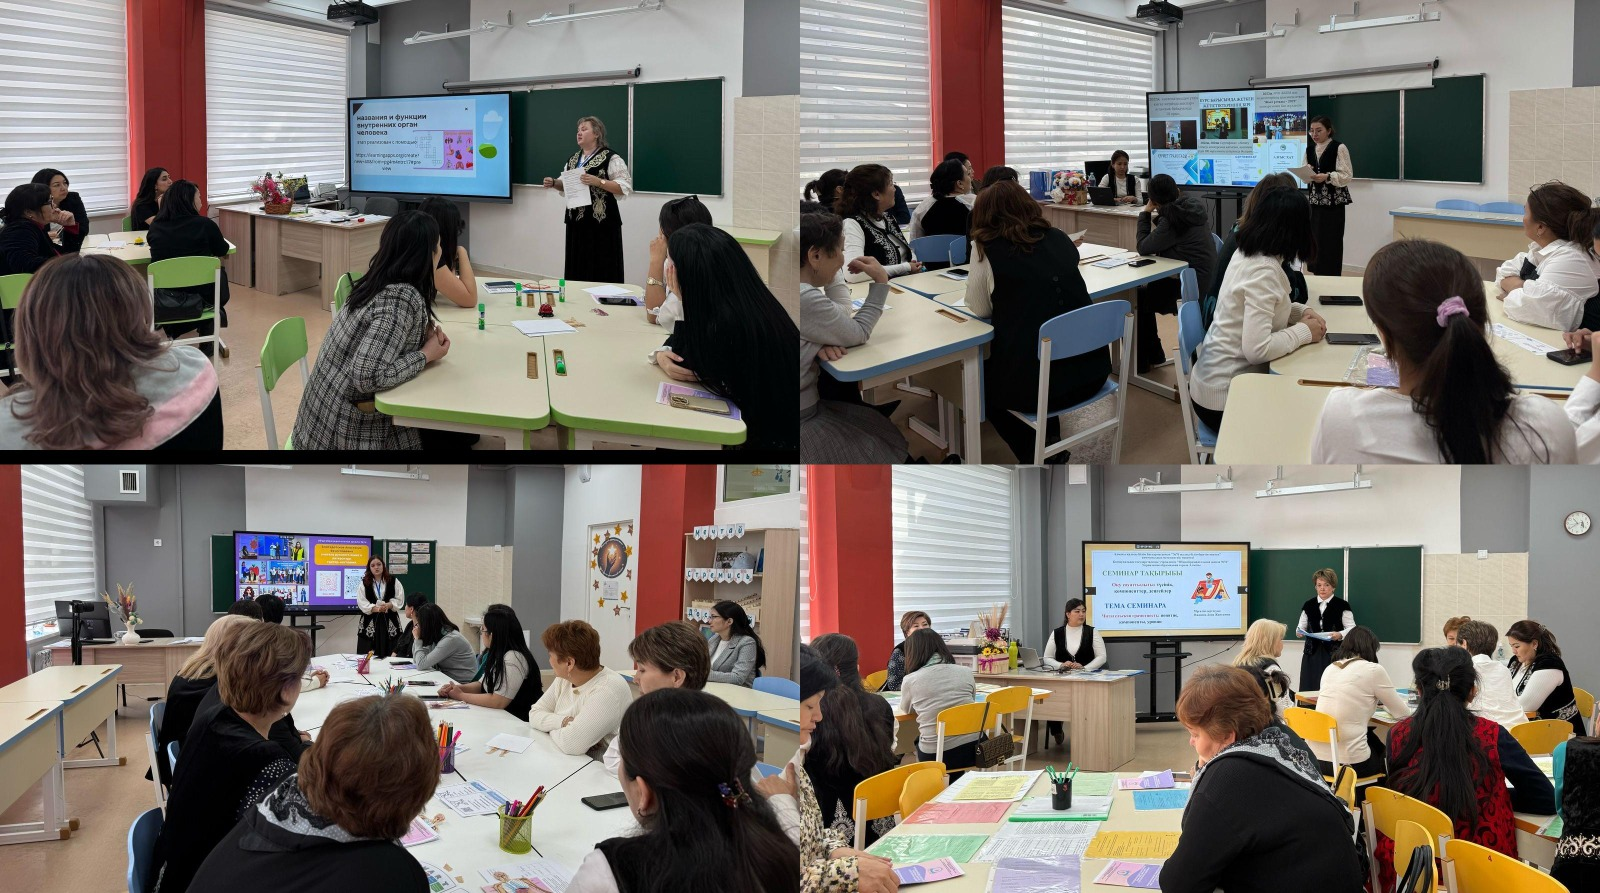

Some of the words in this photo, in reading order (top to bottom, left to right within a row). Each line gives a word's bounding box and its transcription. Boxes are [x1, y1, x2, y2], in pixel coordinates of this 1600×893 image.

[395, 113, 427, 121] функции
[397, 121, 418, 129] орган
[695, 525, 743, 536] Мечтай
[687, 570, 750, 580] Стремись
